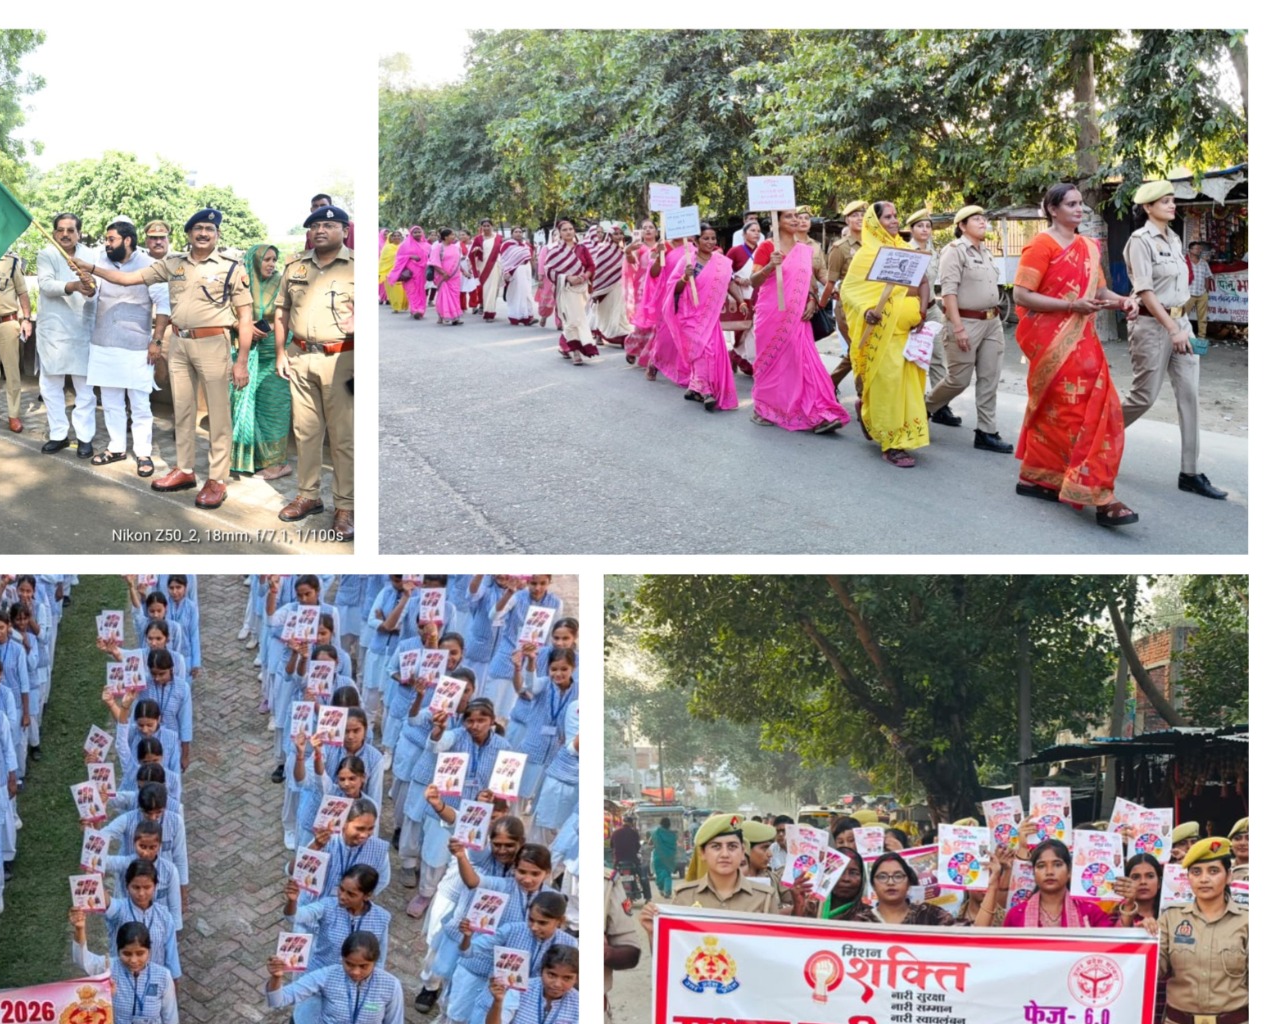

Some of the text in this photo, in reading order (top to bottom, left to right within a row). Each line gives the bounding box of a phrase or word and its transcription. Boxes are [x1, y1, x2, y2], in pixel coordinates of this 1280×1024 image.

[841, 944, 882, 958] मिशन
[846, 945, 971, 1004] शक्ति
[891, 990, 946, 1003] नारी सुरक्षा
[0, 1000, 55, 1023] 2026
[891, 1002, 952, 1014] नारी सम्मान
[891, 1012, 912, 1024] नारी
